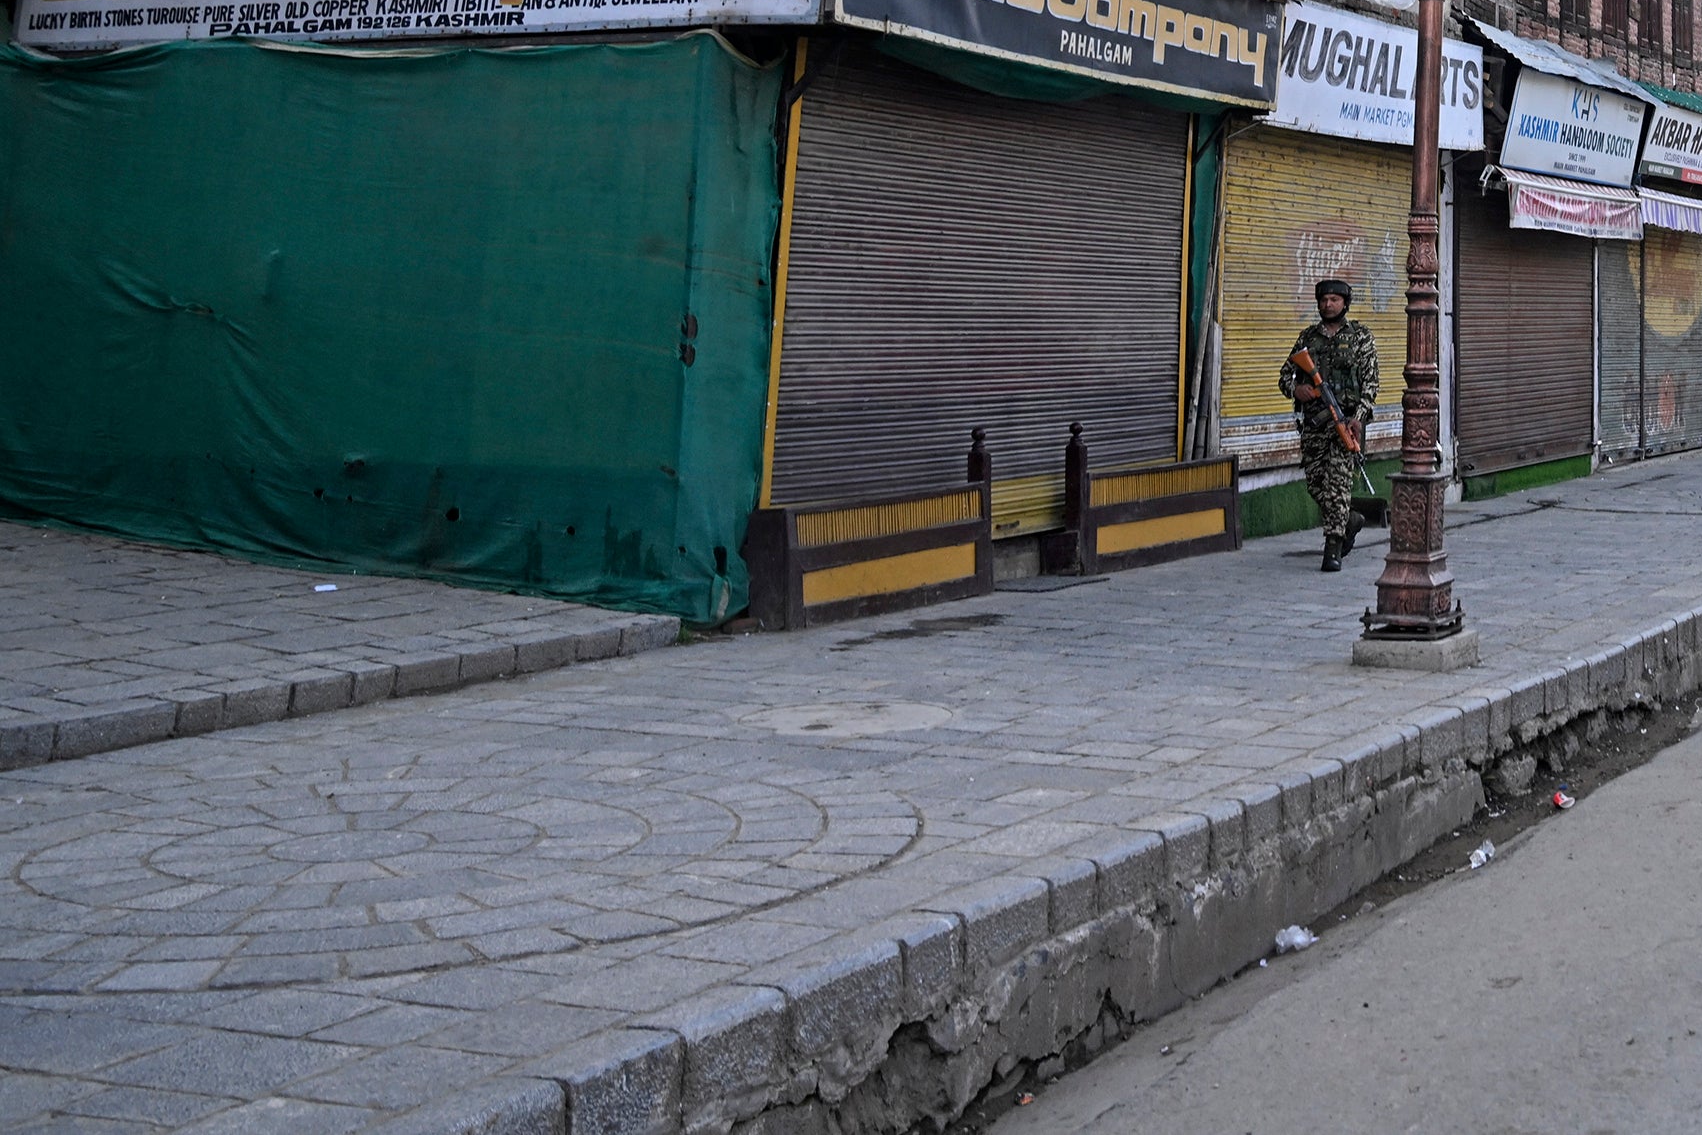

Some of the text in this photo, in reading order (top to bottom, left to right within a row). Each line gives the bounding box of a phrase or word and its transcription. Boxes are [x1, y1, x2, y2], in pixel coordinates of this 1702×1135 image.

[28, 12, 67, 30] LUCKY
[69, 10, 102, 28] BIRTH
[103, 8, 145, 27] STONES
[203, 3, 235, 23] PURE
[238, 1, 281, 21] SILVER
[284, 0, 309, 18] OLD
[208, 18, 352, 37] PAHALGAM
[415, 11, 525, 28] KASHMIR
[1059, 29, 1133, 66] PAHALGAM
[1339, 102, 1360, 121] MAIN
[1362, 105, 1396, 127] MARKET
[1518, 113, 1635, 159] KASHMIR HANDLOOM SOCIETY
[1650, 115, 1693, 152] AKBAR
